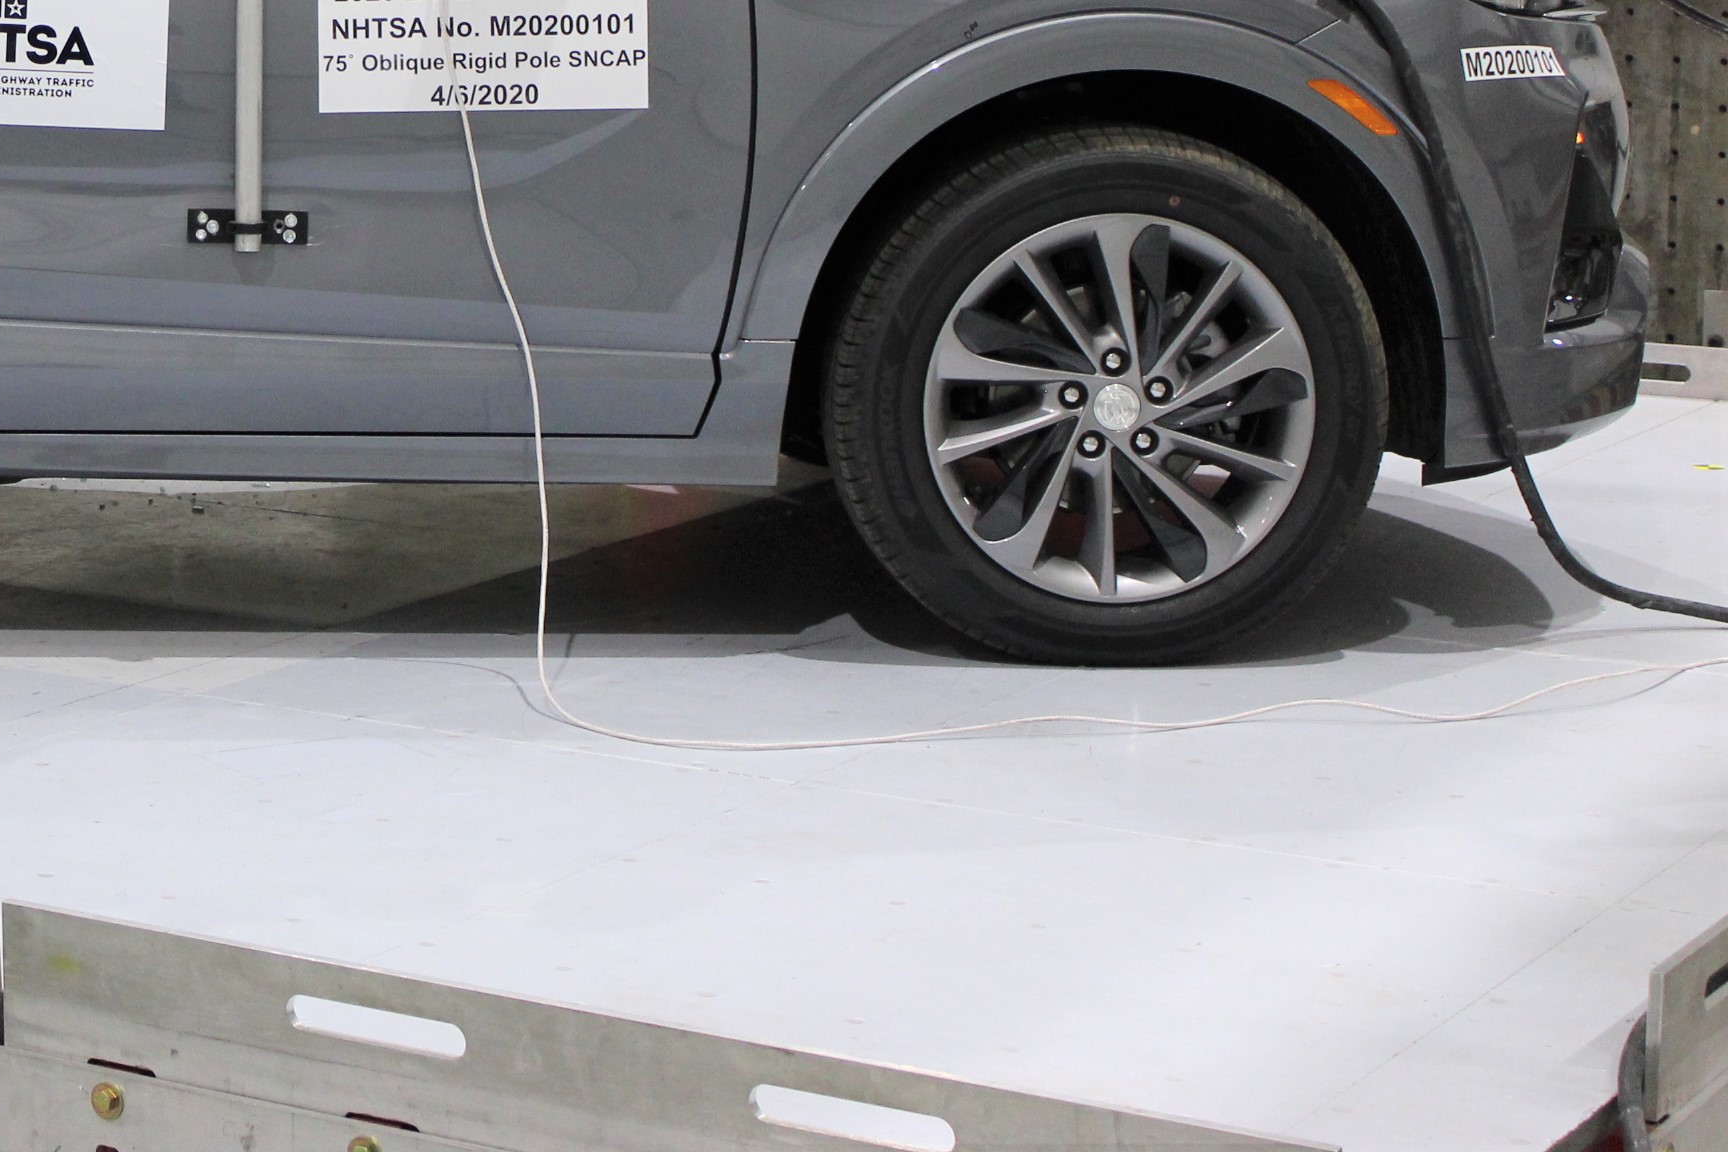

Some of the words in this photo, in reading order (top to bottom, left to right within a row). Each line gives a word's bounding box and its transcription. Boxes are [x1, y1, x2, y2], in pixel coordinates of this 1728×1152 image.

[332, 17, 427, 39] NHTSA
[437, 17, 480, 38] No.
[490, 13, 634, 36] M20200101
[362, 54, 445, 74] Oblique
[452, 52, 508, 74] Rigid
[515, 52, 561, 69] Pole
[569, 49, 646, 67] SNCAP
[1466, 50, 1560, 77] M20200101
[46, 78, 94, 87] TRAFFIC
[431, 84, 540, 106] 4/6/2020
